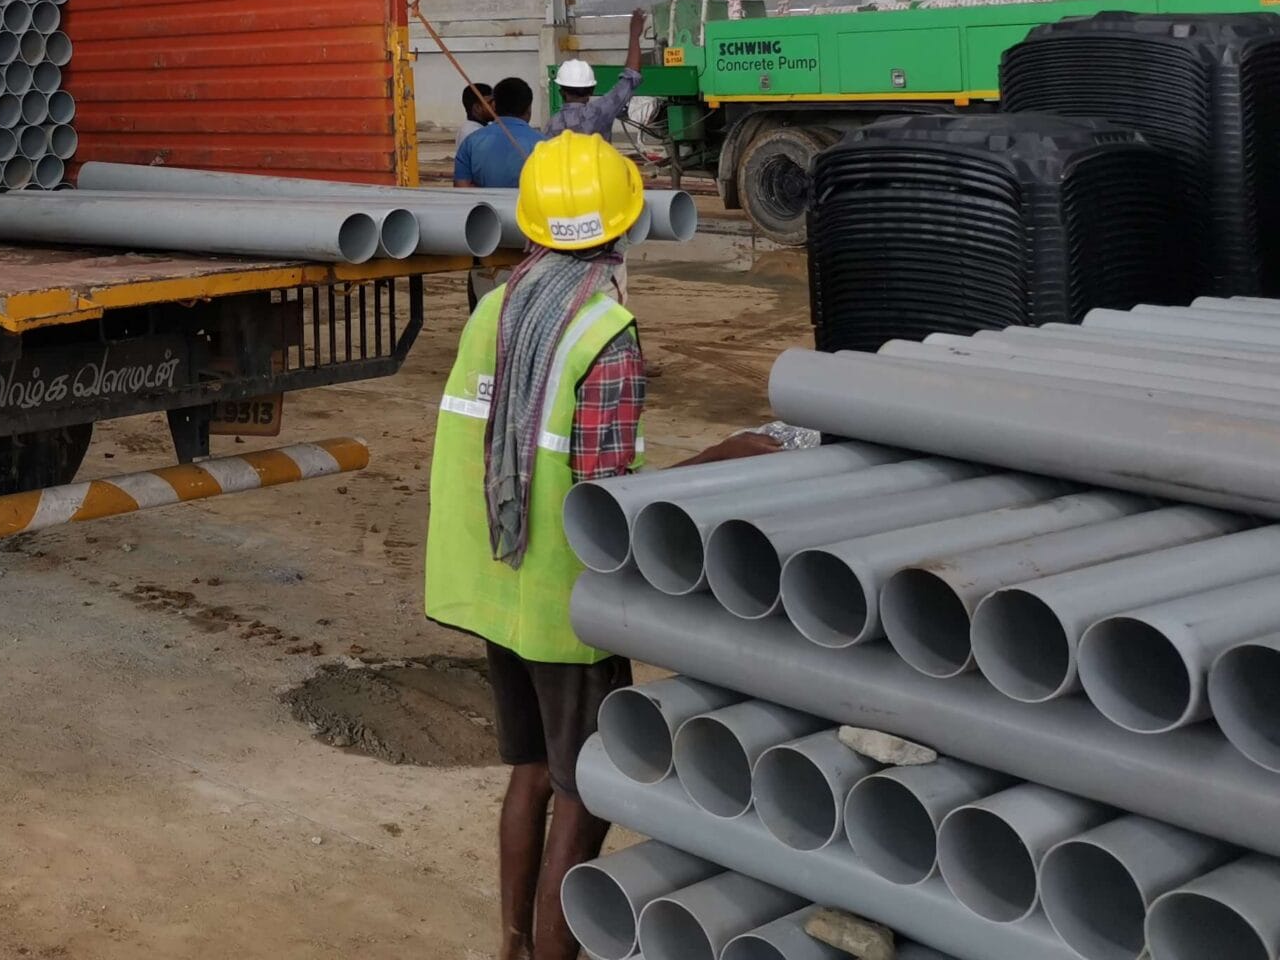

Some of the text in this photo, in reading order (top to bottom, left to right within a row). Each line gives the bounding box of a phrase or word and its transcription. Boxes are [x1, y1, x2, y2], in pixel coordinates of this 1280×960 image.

[719, 41, 782, 56] SCHWING
[717, 56, 817, 72] Concrete Pump
